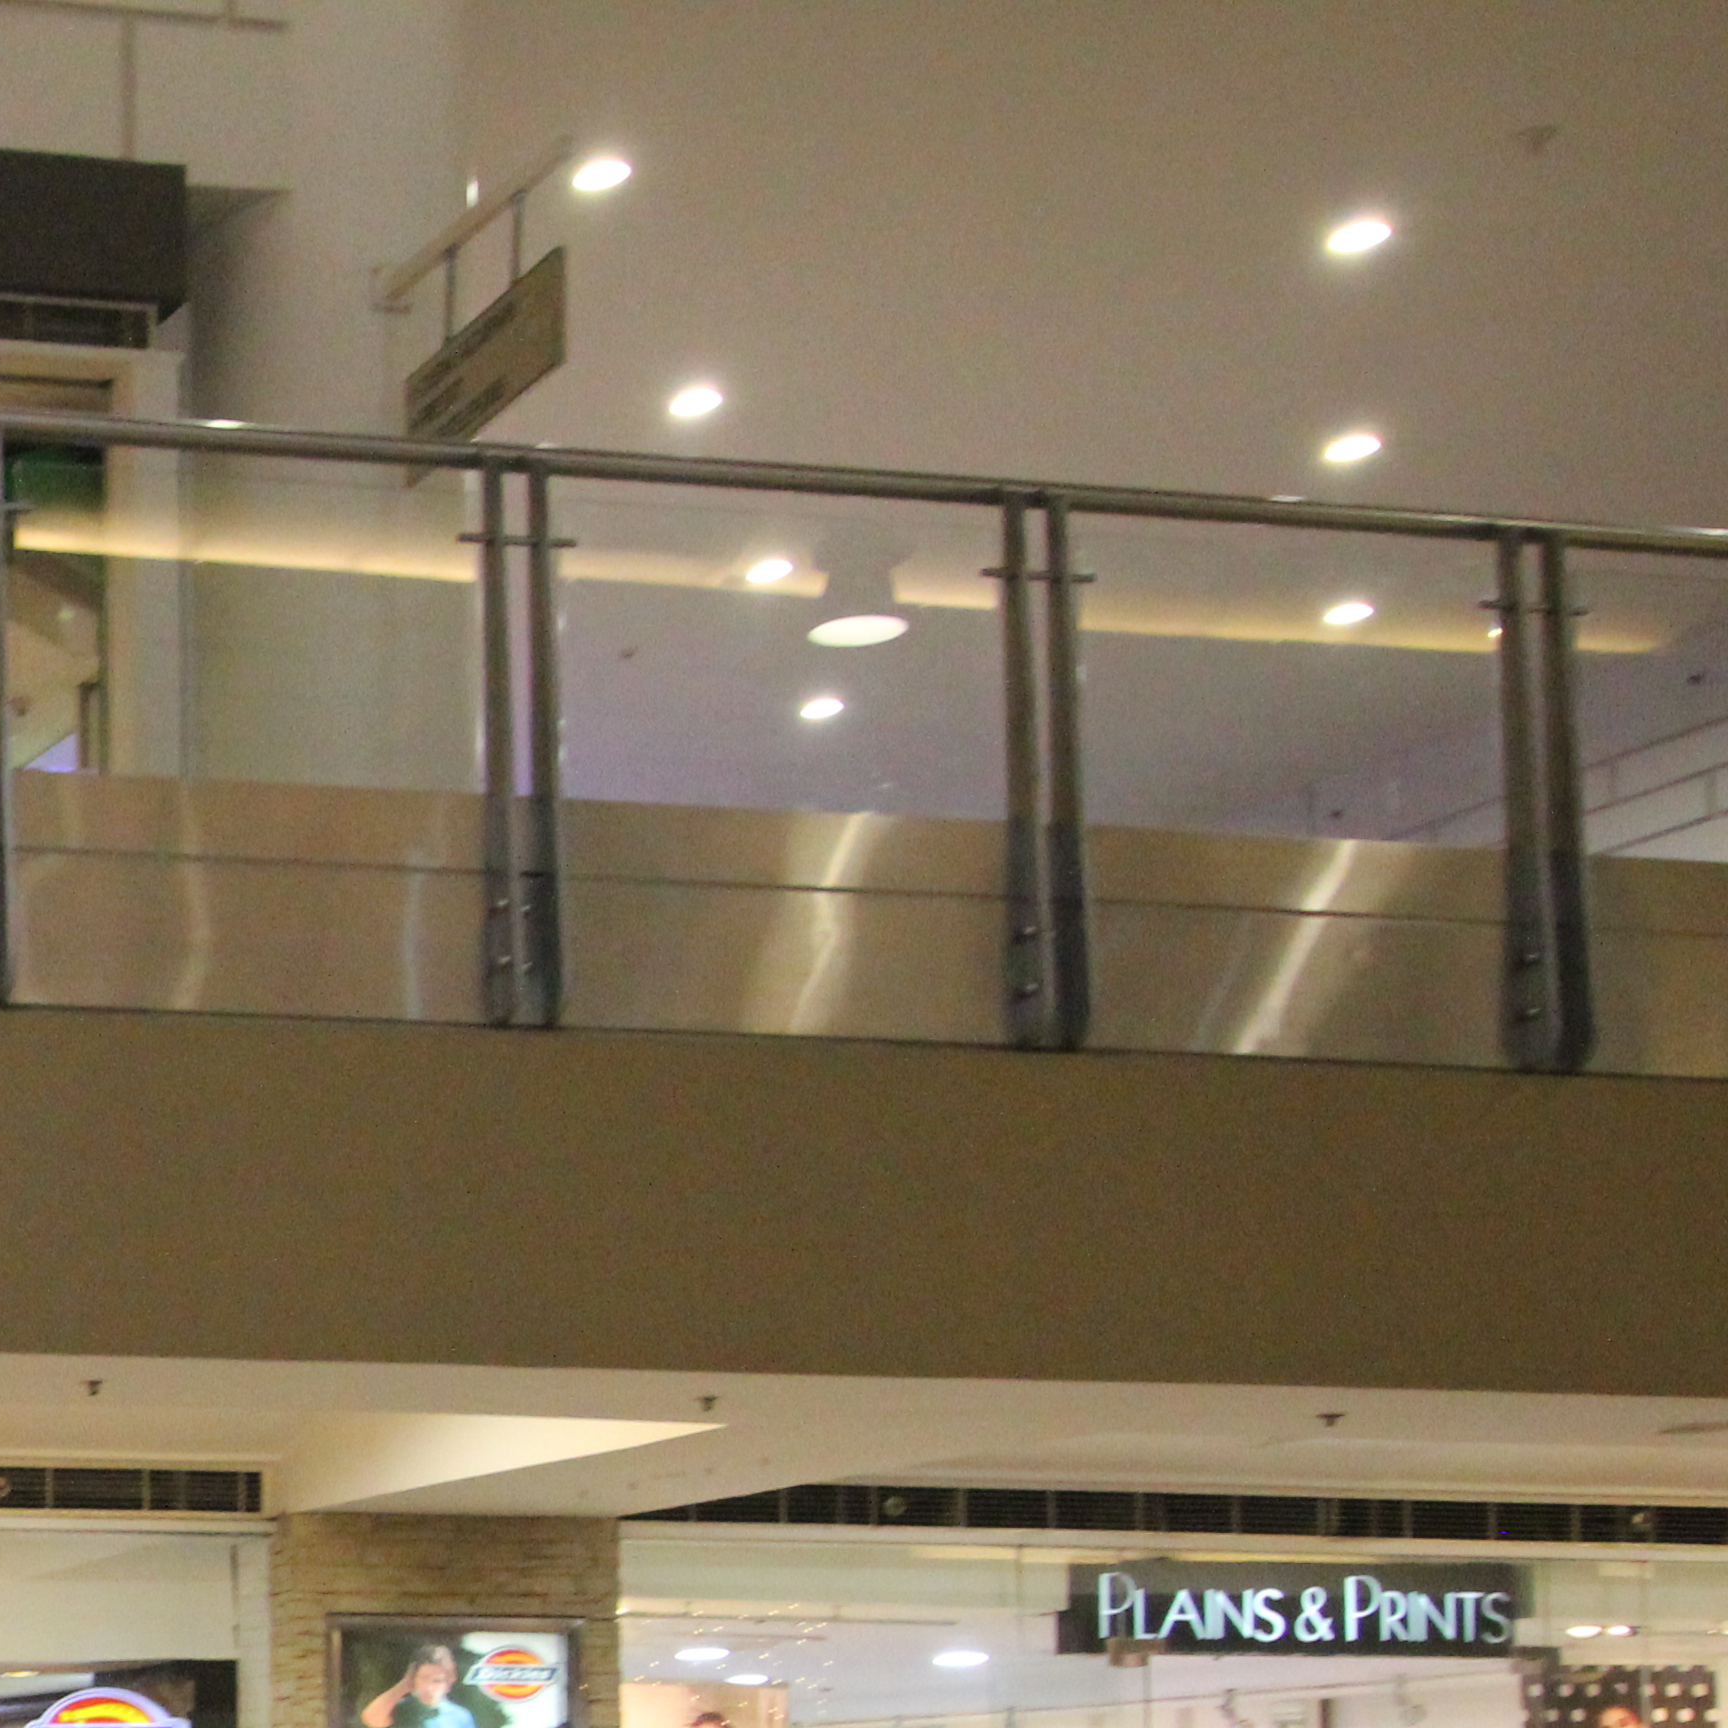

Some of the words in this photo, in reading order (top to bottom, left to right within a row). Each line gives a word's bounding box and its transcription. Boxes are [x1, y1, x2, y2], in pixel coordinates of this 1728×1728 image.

[1097, 1571, 1288, 1642] PLAINS
[1292, 1585, 1336, 1643] &
[1343, 1574, 1512, 1645] PRINTS
